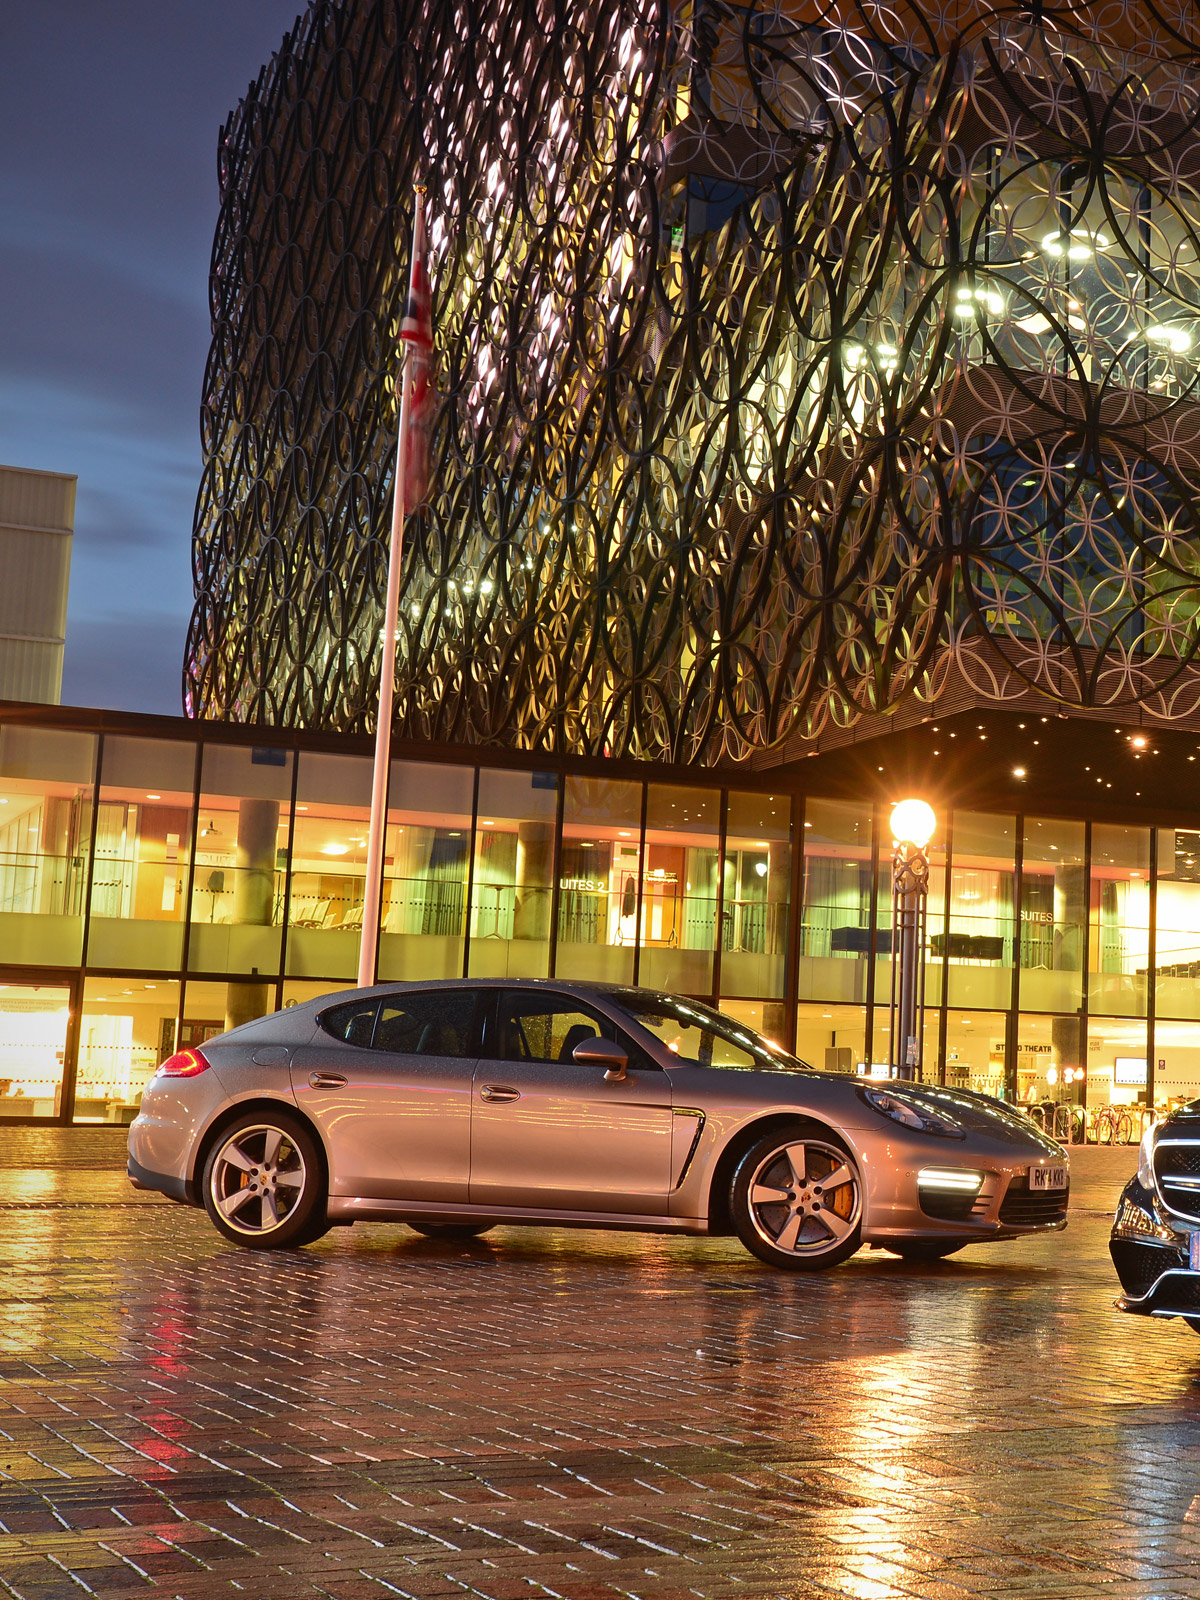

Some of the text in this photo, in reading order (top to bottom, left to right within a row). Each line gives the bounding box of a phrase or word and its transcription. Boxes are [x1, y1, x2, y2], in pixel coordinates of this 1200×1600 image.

[560, 879, 595, 891] UITES
[1020, 910, 1053, 922] SUITES
[1024, 1044, 1052, 1053] THEATR
